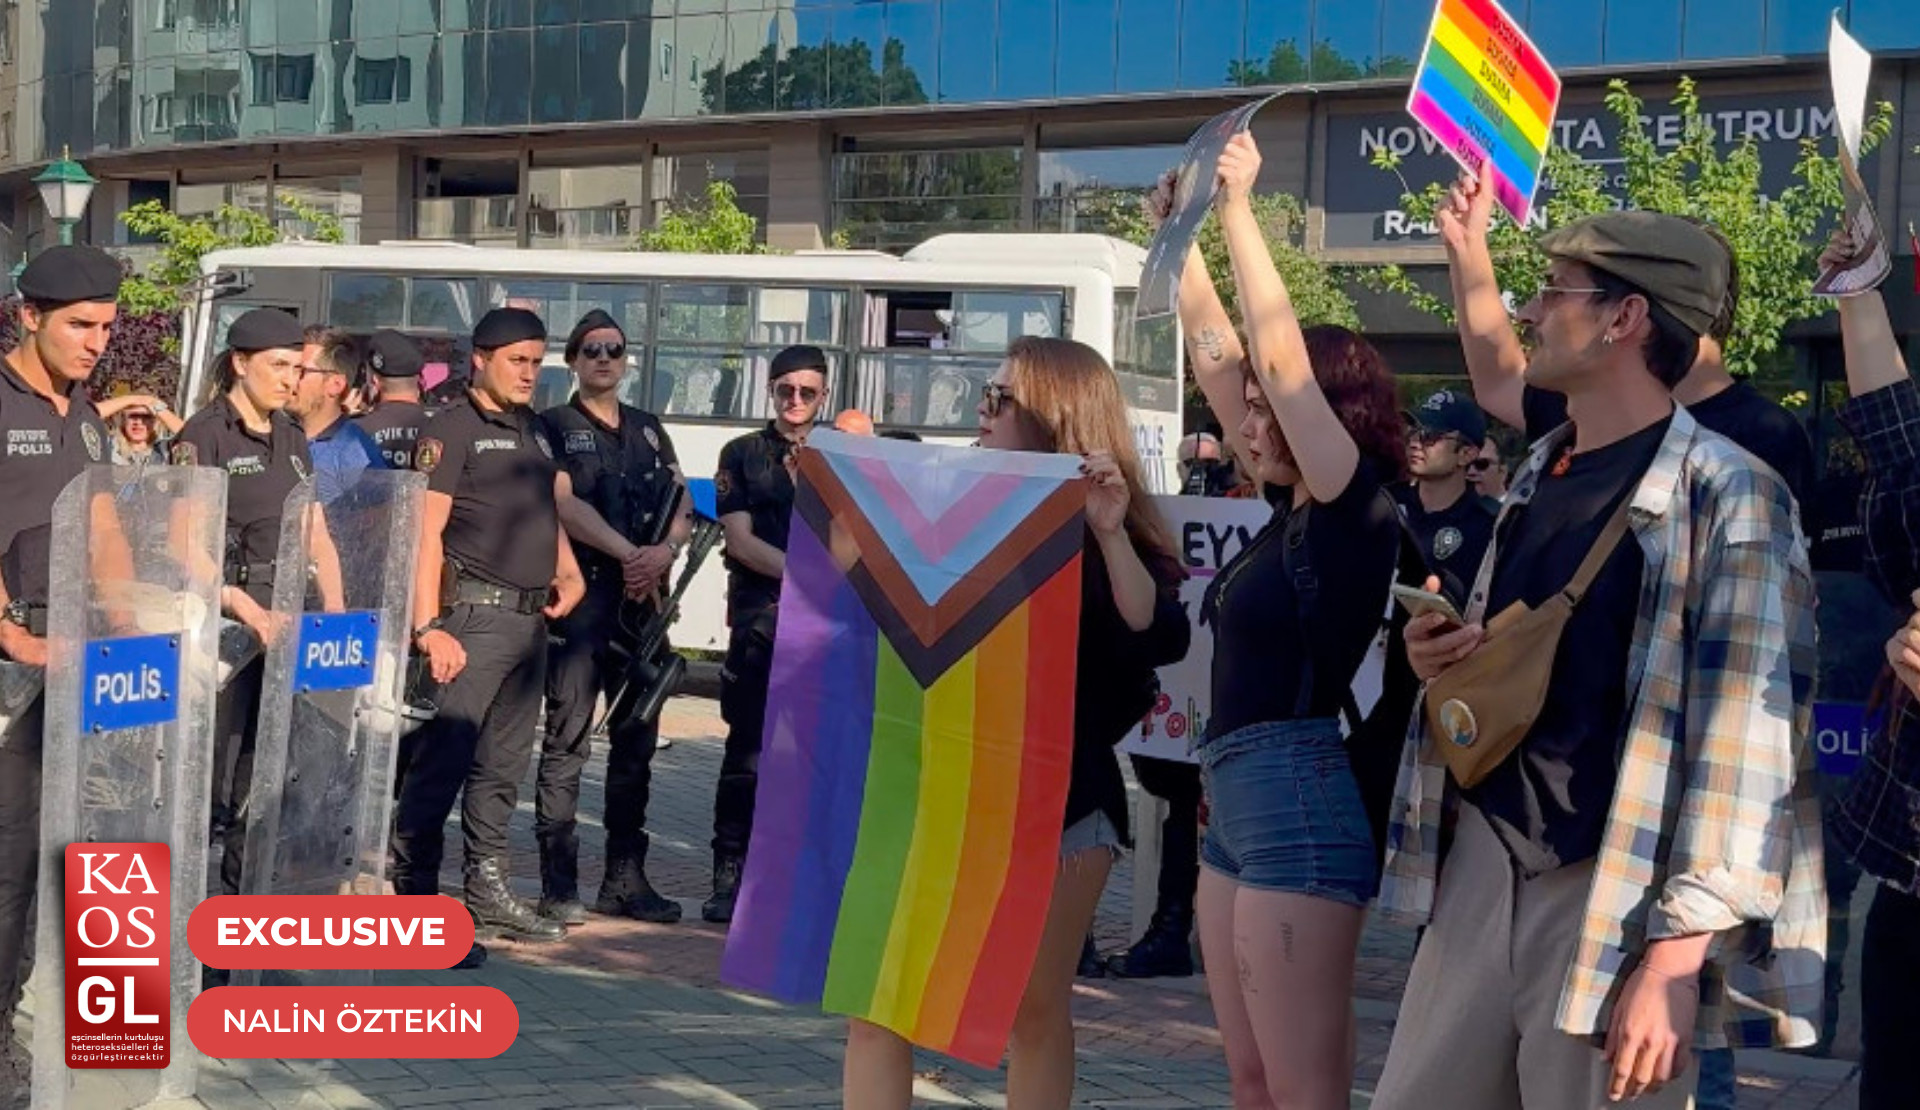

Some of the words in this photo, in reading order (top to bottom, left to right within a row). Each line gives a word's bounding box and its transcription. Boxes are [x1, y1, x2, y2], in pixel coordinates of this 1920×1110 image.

[1359, 126, 1449, 157] NOV
[95, 663, 161, 706] POLİS
[1817, 728, 1868, 756] OLİ
